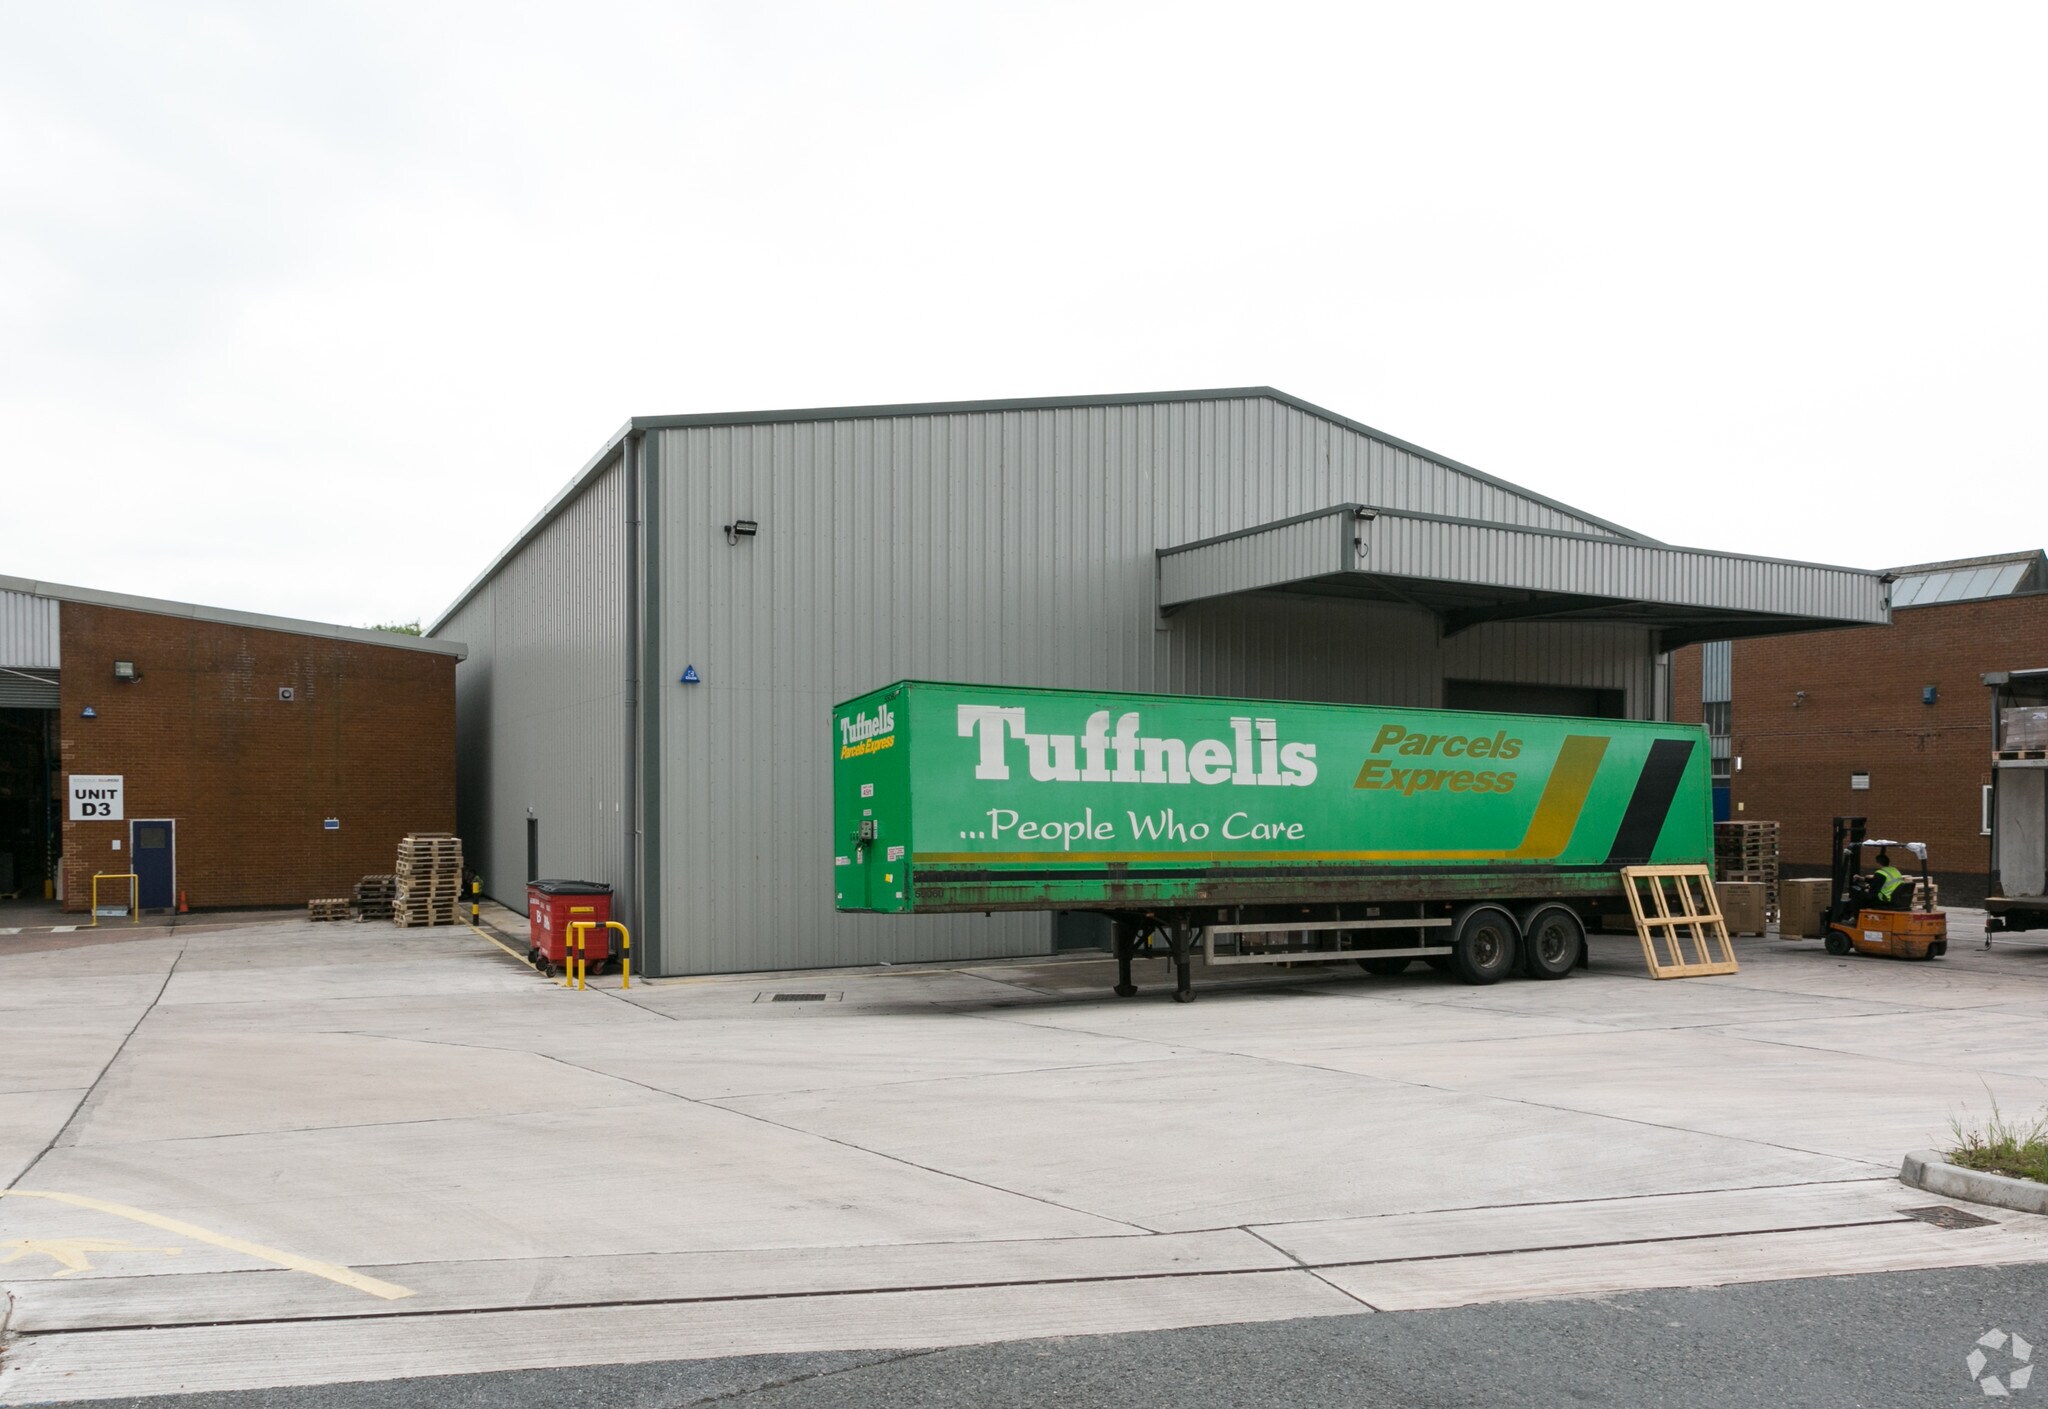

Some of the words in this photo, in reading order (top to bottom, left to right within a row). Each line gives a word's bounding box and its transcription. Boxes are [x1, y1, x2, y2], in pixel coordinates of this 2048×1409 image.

[840, 704, 895, 745] Tuffnells
[1370, 724, 1524, 760] Parcels
[957, 704, 1318, 787] Tuffnells
[75, 789, 118, 800] UNIT
[1353, 759, 1517, 796] Express
[82, 802, 111, 817] D3
[1126, 808, 1210, 843] Who
[1222, 811, 1306, 840] Care
